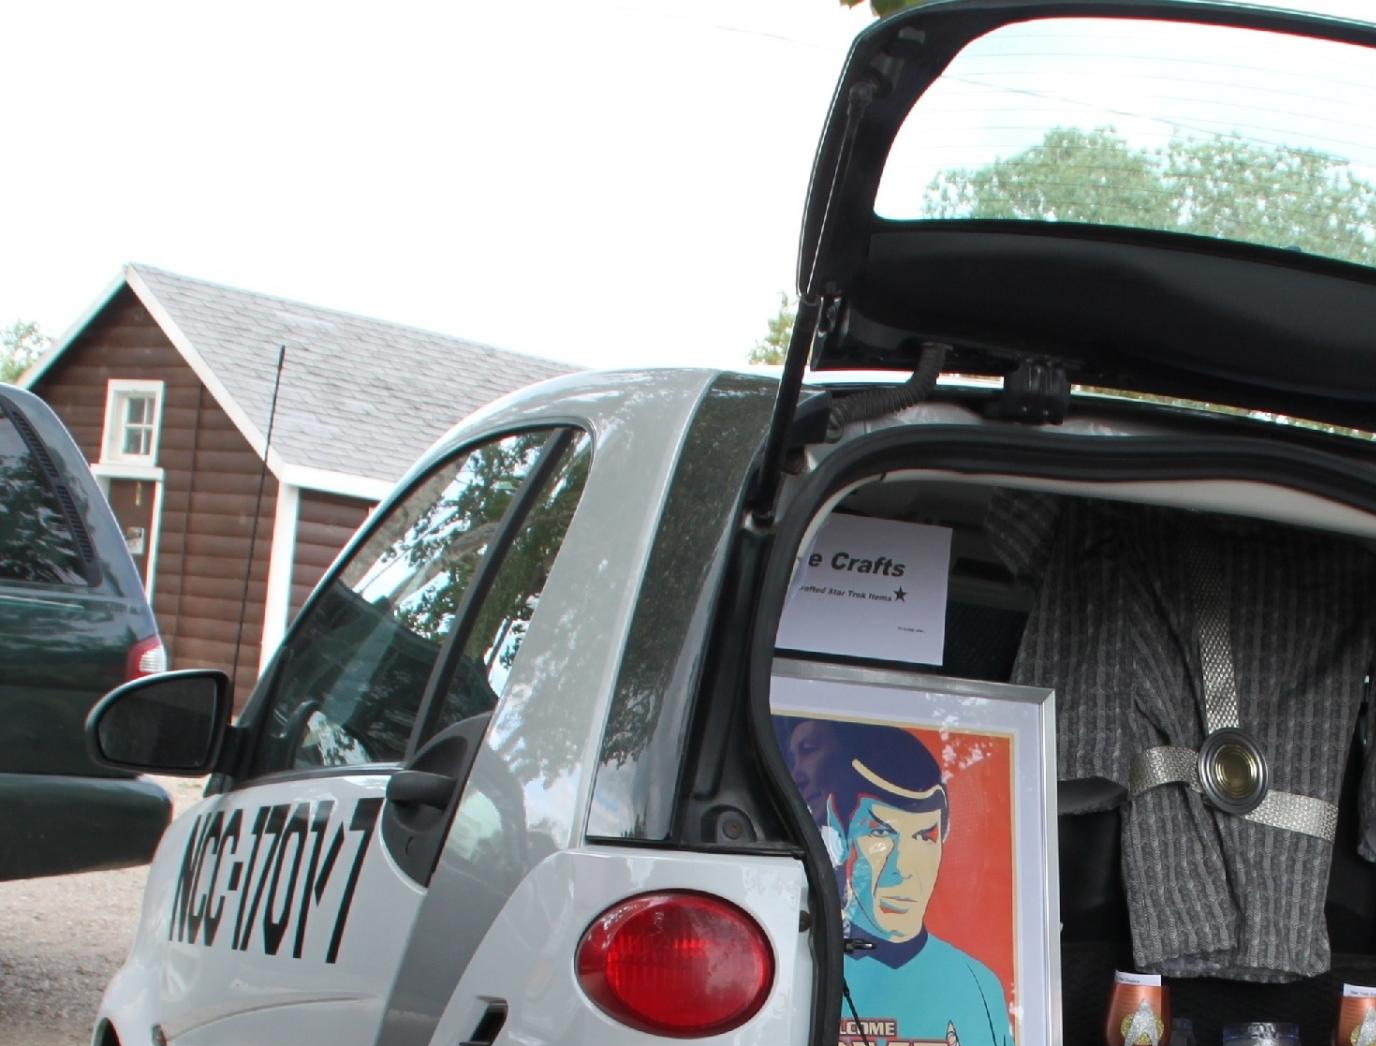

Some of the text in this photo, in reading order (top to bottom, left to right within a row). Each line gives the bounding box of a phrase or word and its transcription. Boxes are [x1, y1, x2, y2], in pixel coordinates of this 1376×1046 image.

[831, 552, 906, 577] Crafts
[828, 587, 845, 597] Star
[848, 590, 866, 600] Trek
